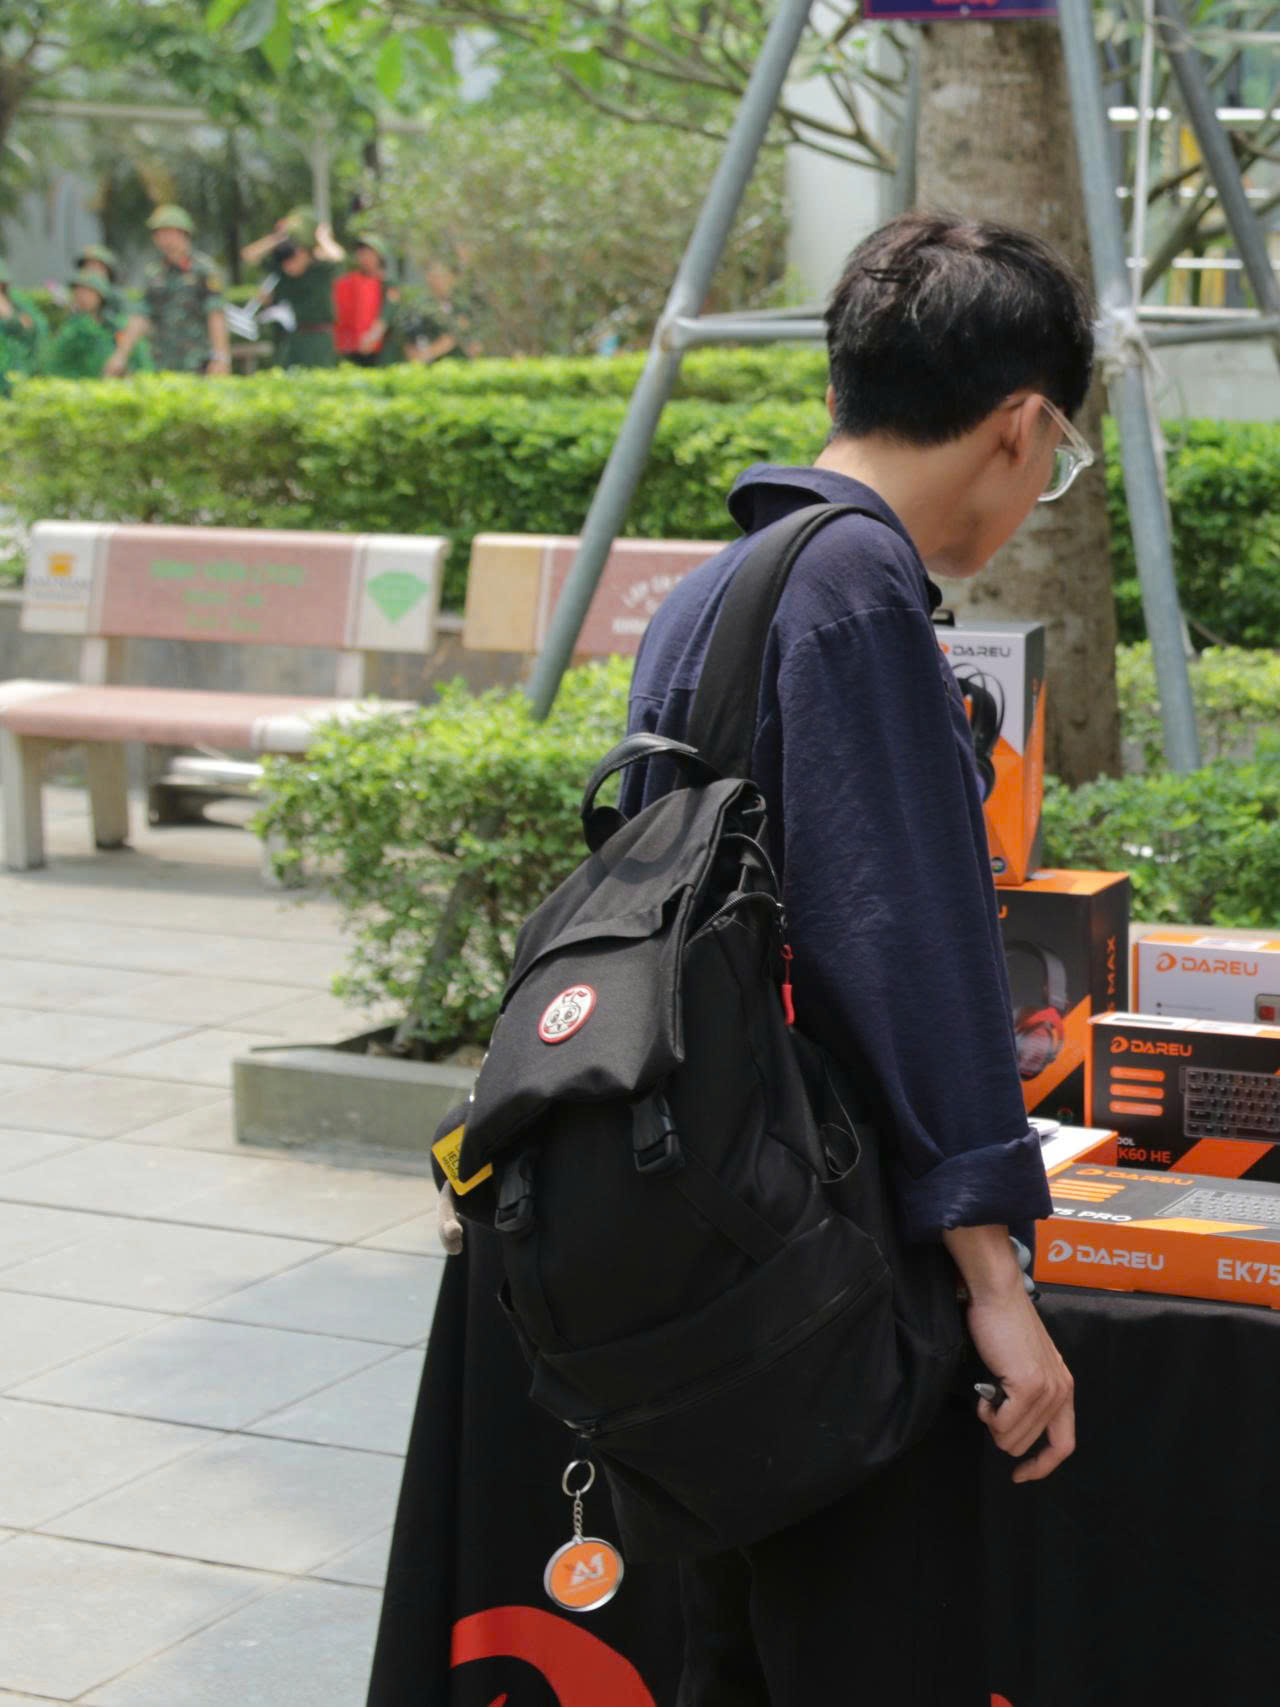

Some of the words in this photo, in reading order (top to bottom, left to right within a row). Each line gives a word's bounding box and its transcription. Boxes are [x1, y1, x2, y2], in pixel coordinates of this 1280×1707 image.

[952, 646, 1011, 657] DAREU
[1182, 957, 1259, 977] DAREU
[1130, 1039, 1193, 1057] DAREU
[1118, 1146, 1147, 1161] K60
[1151, 1150, 1171, 1164] HE
[1105, 1170, 1194, 1186] DAREU
[1077, 1210, 1132, 1221] PRO
[1076, 1244, 1165, 1271] DAREU
